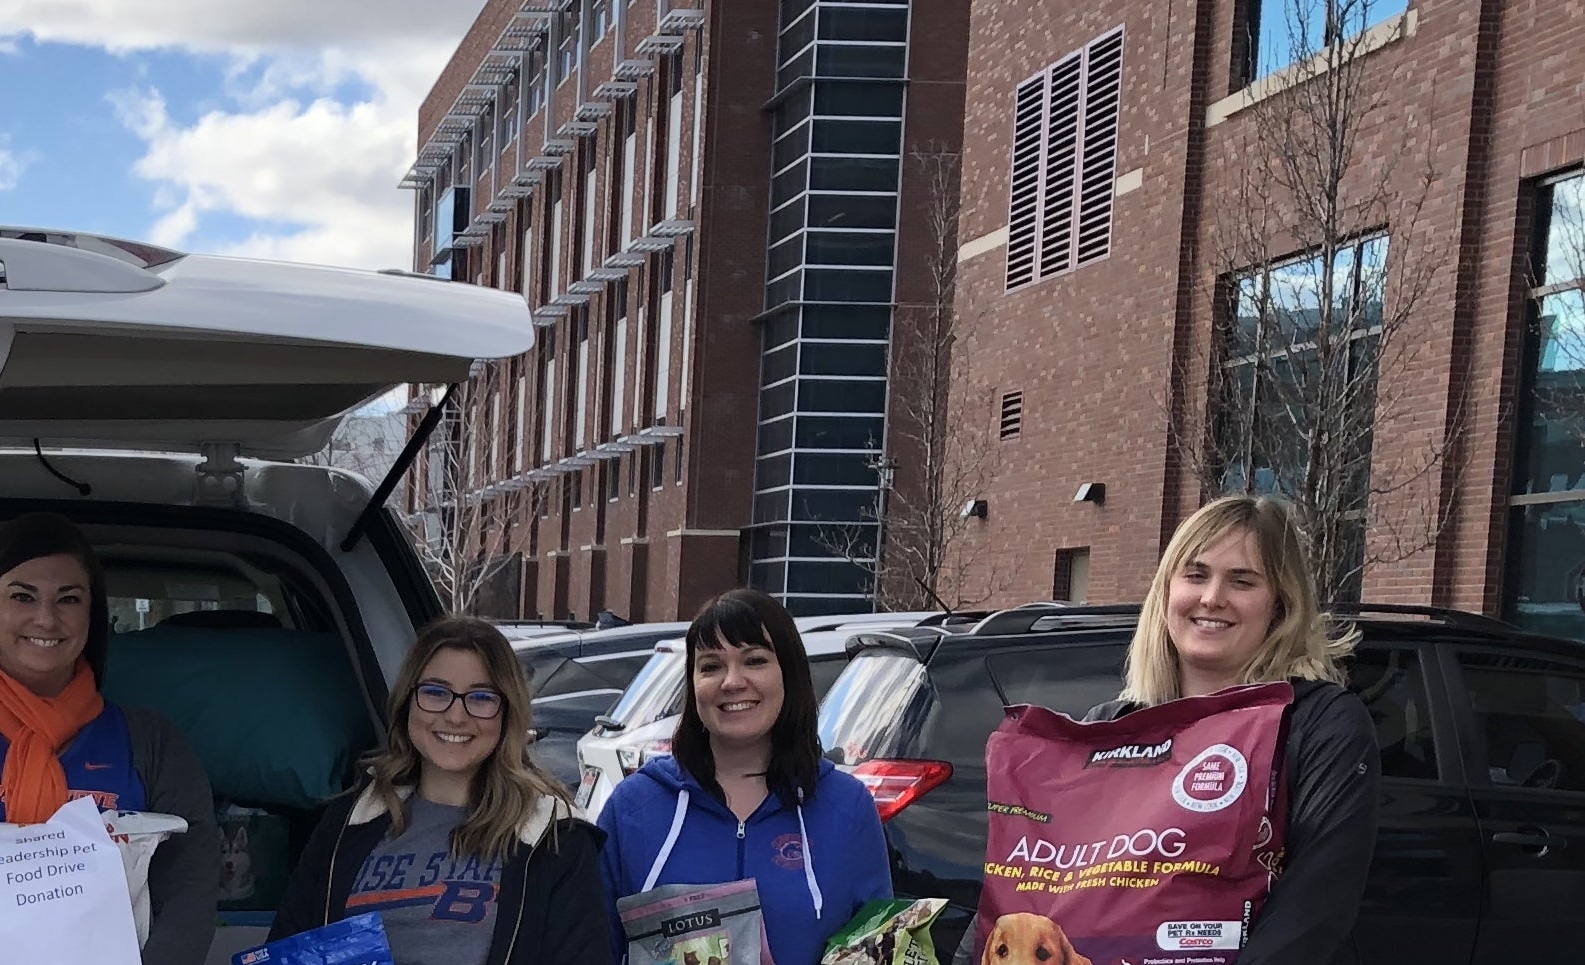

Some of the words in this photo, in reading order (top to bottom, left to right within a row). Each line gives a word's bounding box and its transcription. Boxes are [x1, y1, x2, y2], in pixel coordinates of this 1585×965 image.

[1092, 738, 1172, 763] KIRKLAND
[1194, 772, 1225, 781] PREMIUM
[1202, 761, 1221, 771] SAME
[1191, 782, 1223, 791] FORMULA
[73, 842, 97, 854] Pet
[1007, 836, 1107, 868] ADULT
[1107, 828, 1186, 859] DOG
[6, 867, 42, 884] Food
[47, 862, 85, 876] Drive
[1029, 866, 1061, 881] RICE
[1079, 860, 1148, 879] VEGETABLE
[1153, 860, 1220, 876] FORMULA
[16, 884, 83, 906] Donation
[1016, 881, 1045, 892] MADE
[1048, 883, 1075, 894] WITH
[1075, 878, 1106, 890] FRESH
[1109, 877, 1160, 888] CHICKEN
[429, 880, 497, 925] B
[668, 913, 713, 934] LOTUS
